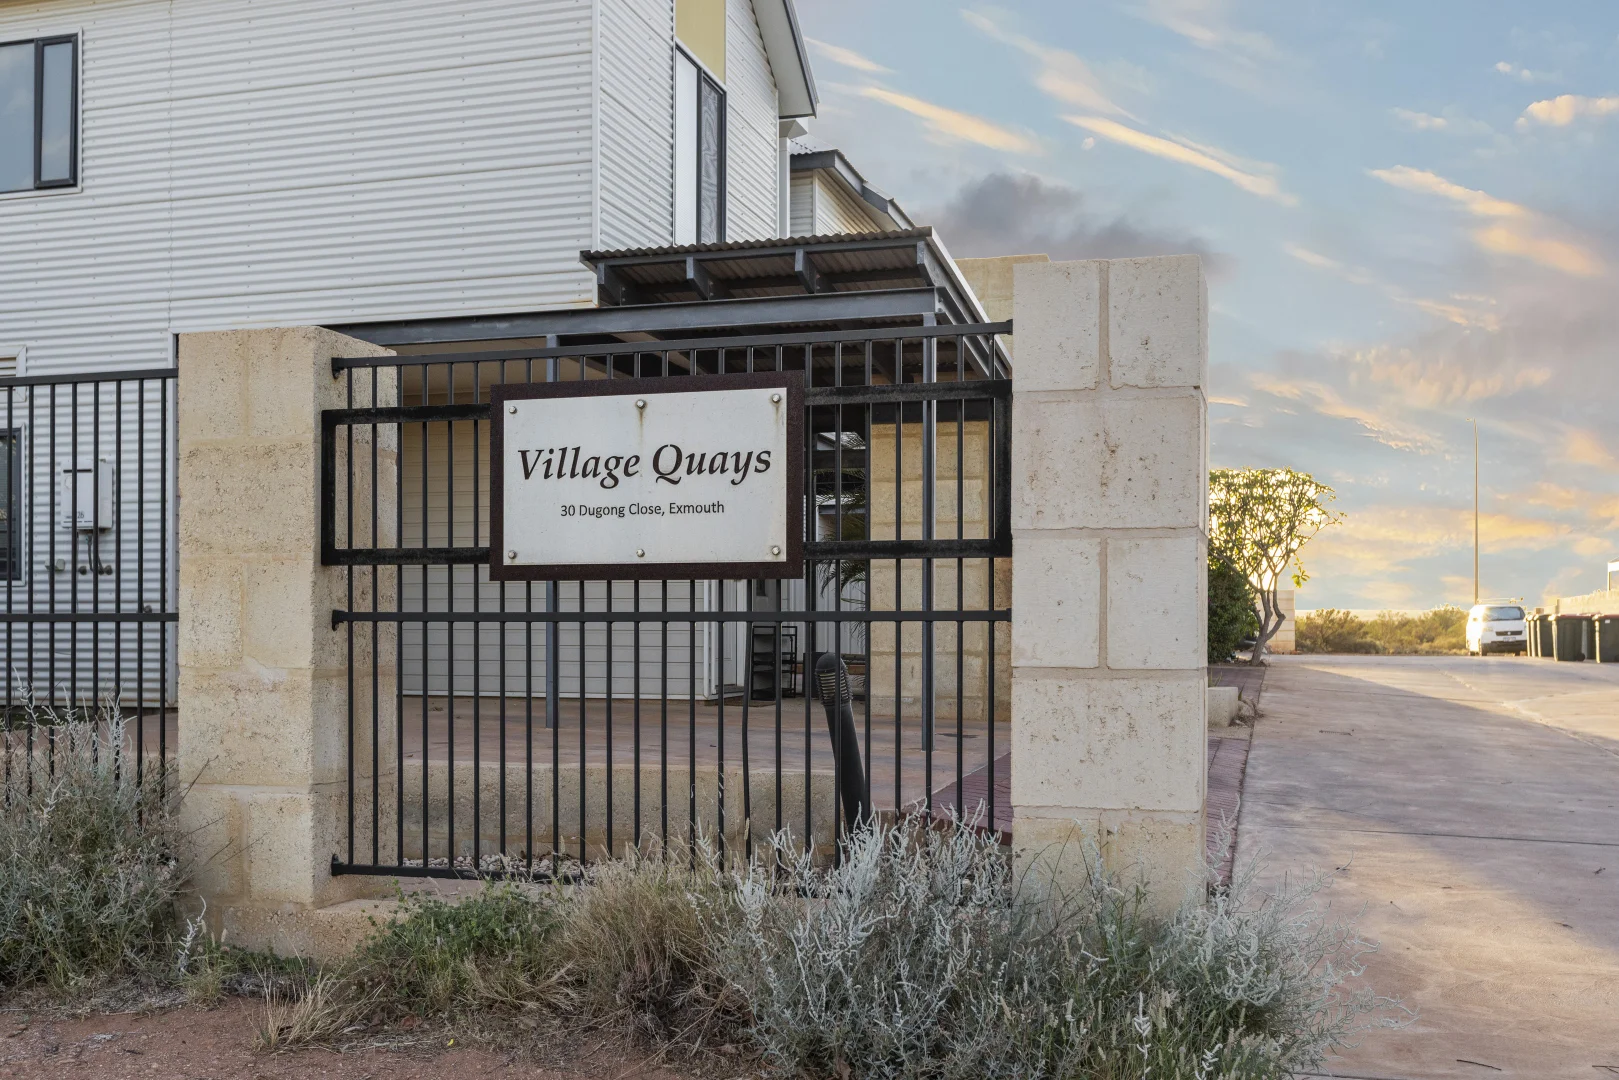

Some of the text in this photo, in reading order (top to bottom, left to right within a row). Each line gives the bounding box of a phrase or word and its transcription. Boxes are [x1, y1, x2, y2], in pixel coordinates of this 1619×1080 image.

[517, 443, 772, 490] Village Quays
[560, 501, 725, 519] 30 Dugong Close, Exmouth
